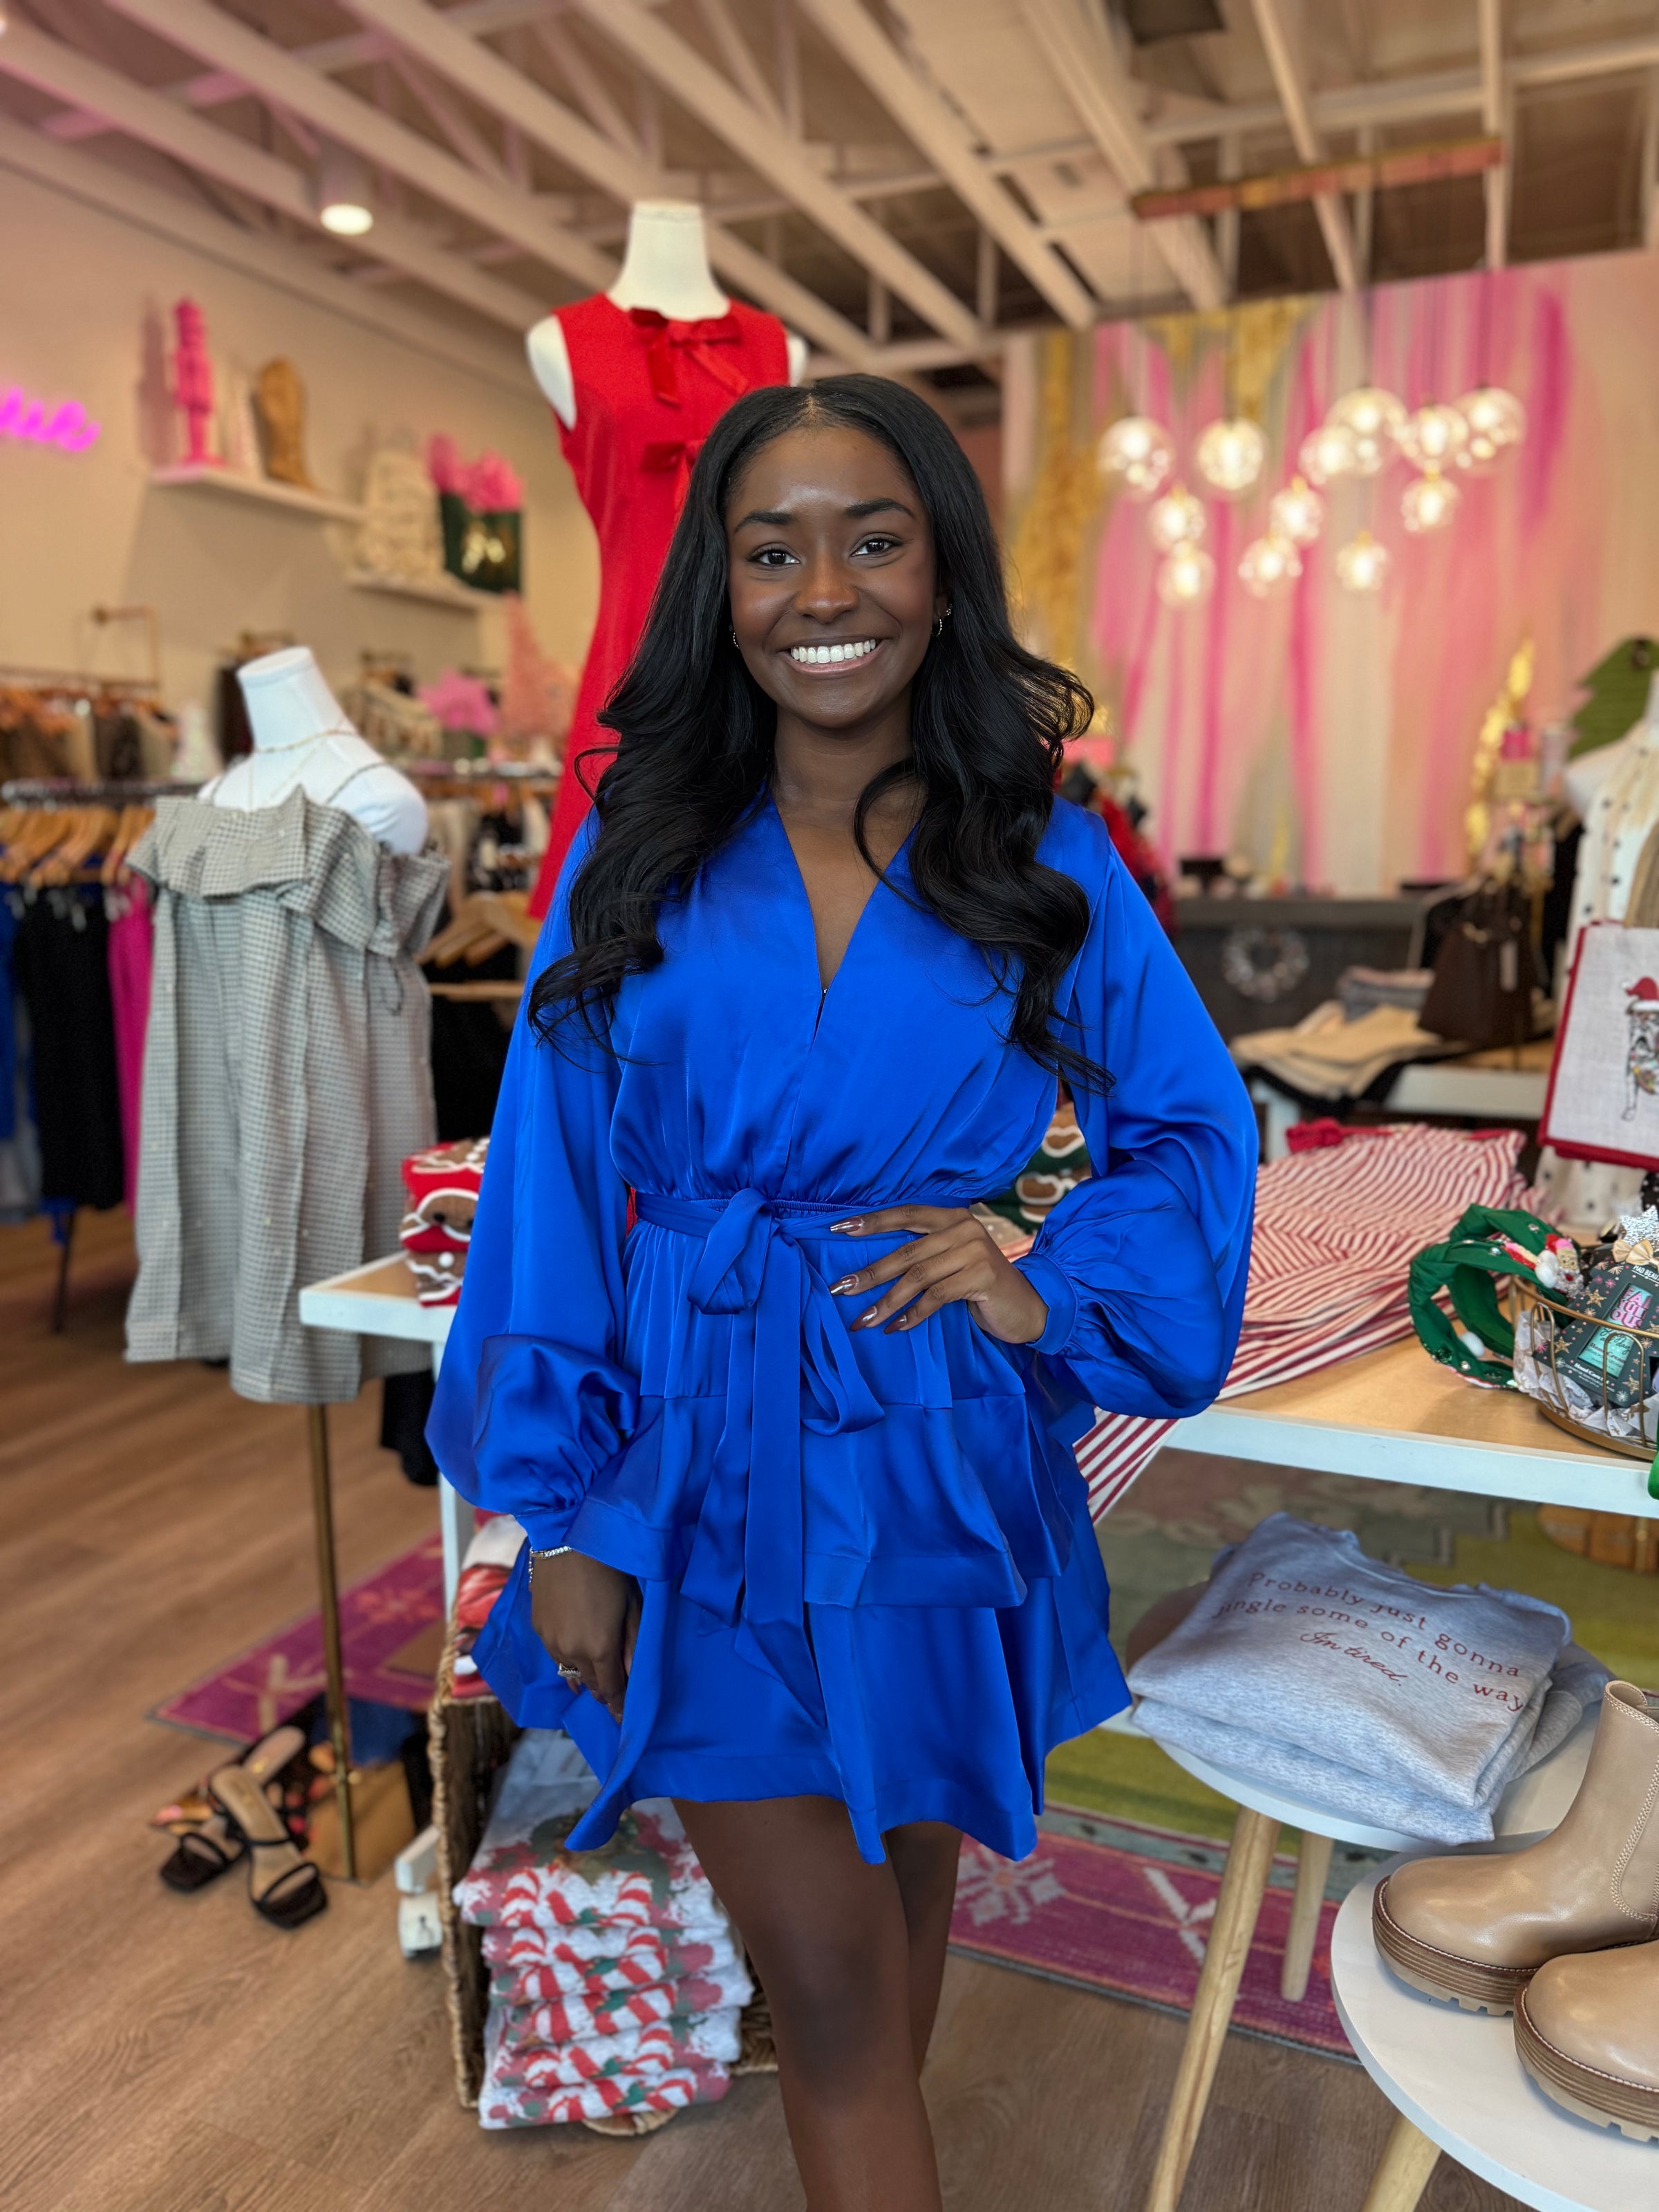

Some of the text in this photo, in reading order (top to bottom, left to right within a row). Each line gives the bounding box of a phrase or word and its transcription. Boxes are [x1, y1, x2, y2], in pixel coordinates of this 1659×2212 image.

[1633, 1265, 1659, 1282] MAD BEAU
[1212, 1598, 1524, 1712] jingle some of the way
[1248, 1571, 1519, 1677] Probably just gonna
